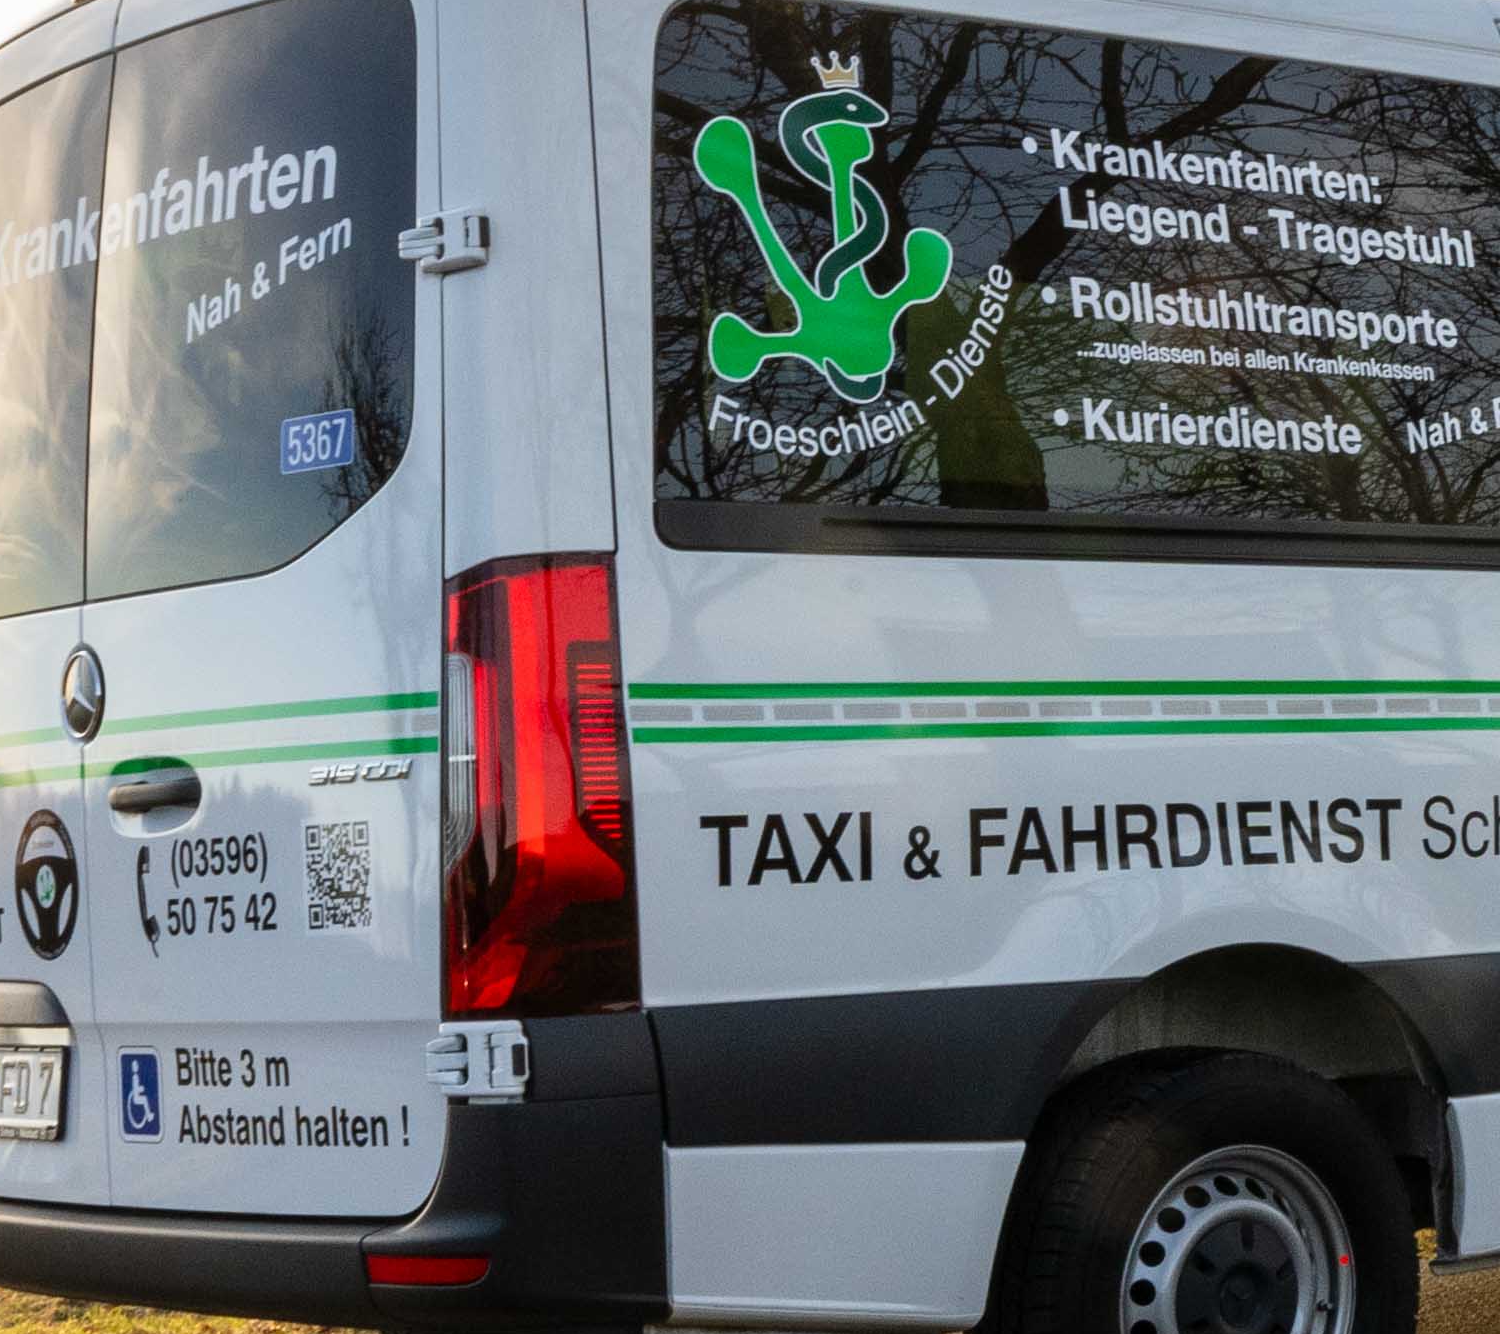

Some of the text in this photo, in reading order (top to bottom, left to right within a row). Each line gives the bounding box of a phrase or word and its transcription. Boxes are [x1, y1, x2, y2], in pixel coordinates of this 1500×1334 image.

[1050, 128, 1382, 205] Krankenfahrten:
[1059, 185, 1230, 246] Liegend
[1268, 208, 1475, 269] Tragestuhl
[186, 216, 352, 344] Nah & Fern
[1069, 275, 1458, 349] Rollstuhltransporte
[708, 394, 927, 458] Froeschlein
[929, 264, 1013, 400] Dienste
[1210, 345, 1240, 369] bei
[1244, 349, 1289, 372] allen
[1293, 350, 1434, 382] Krankenkassen
[287, 417, 348, 467] 5367
[1083, 398, 1362, 456] Kurierdienste
[1407, 410, 1461, 454] Nah
[1470, 407, 1488, 436] &
[360, 758, 413, 782] CDI
[171, 831, 268, 889] (03596)
[700, 810, 872, 887] TAXI
[903, 824, 941, 880] &
[968, 798, 1402, 877] FAHRDIENST
[167, 892, 277, 936] 50 75 42
[175, 1047, 290, 1088] Bitte 3 m
[178, 1104, 410, 1147] Abstand halten !
